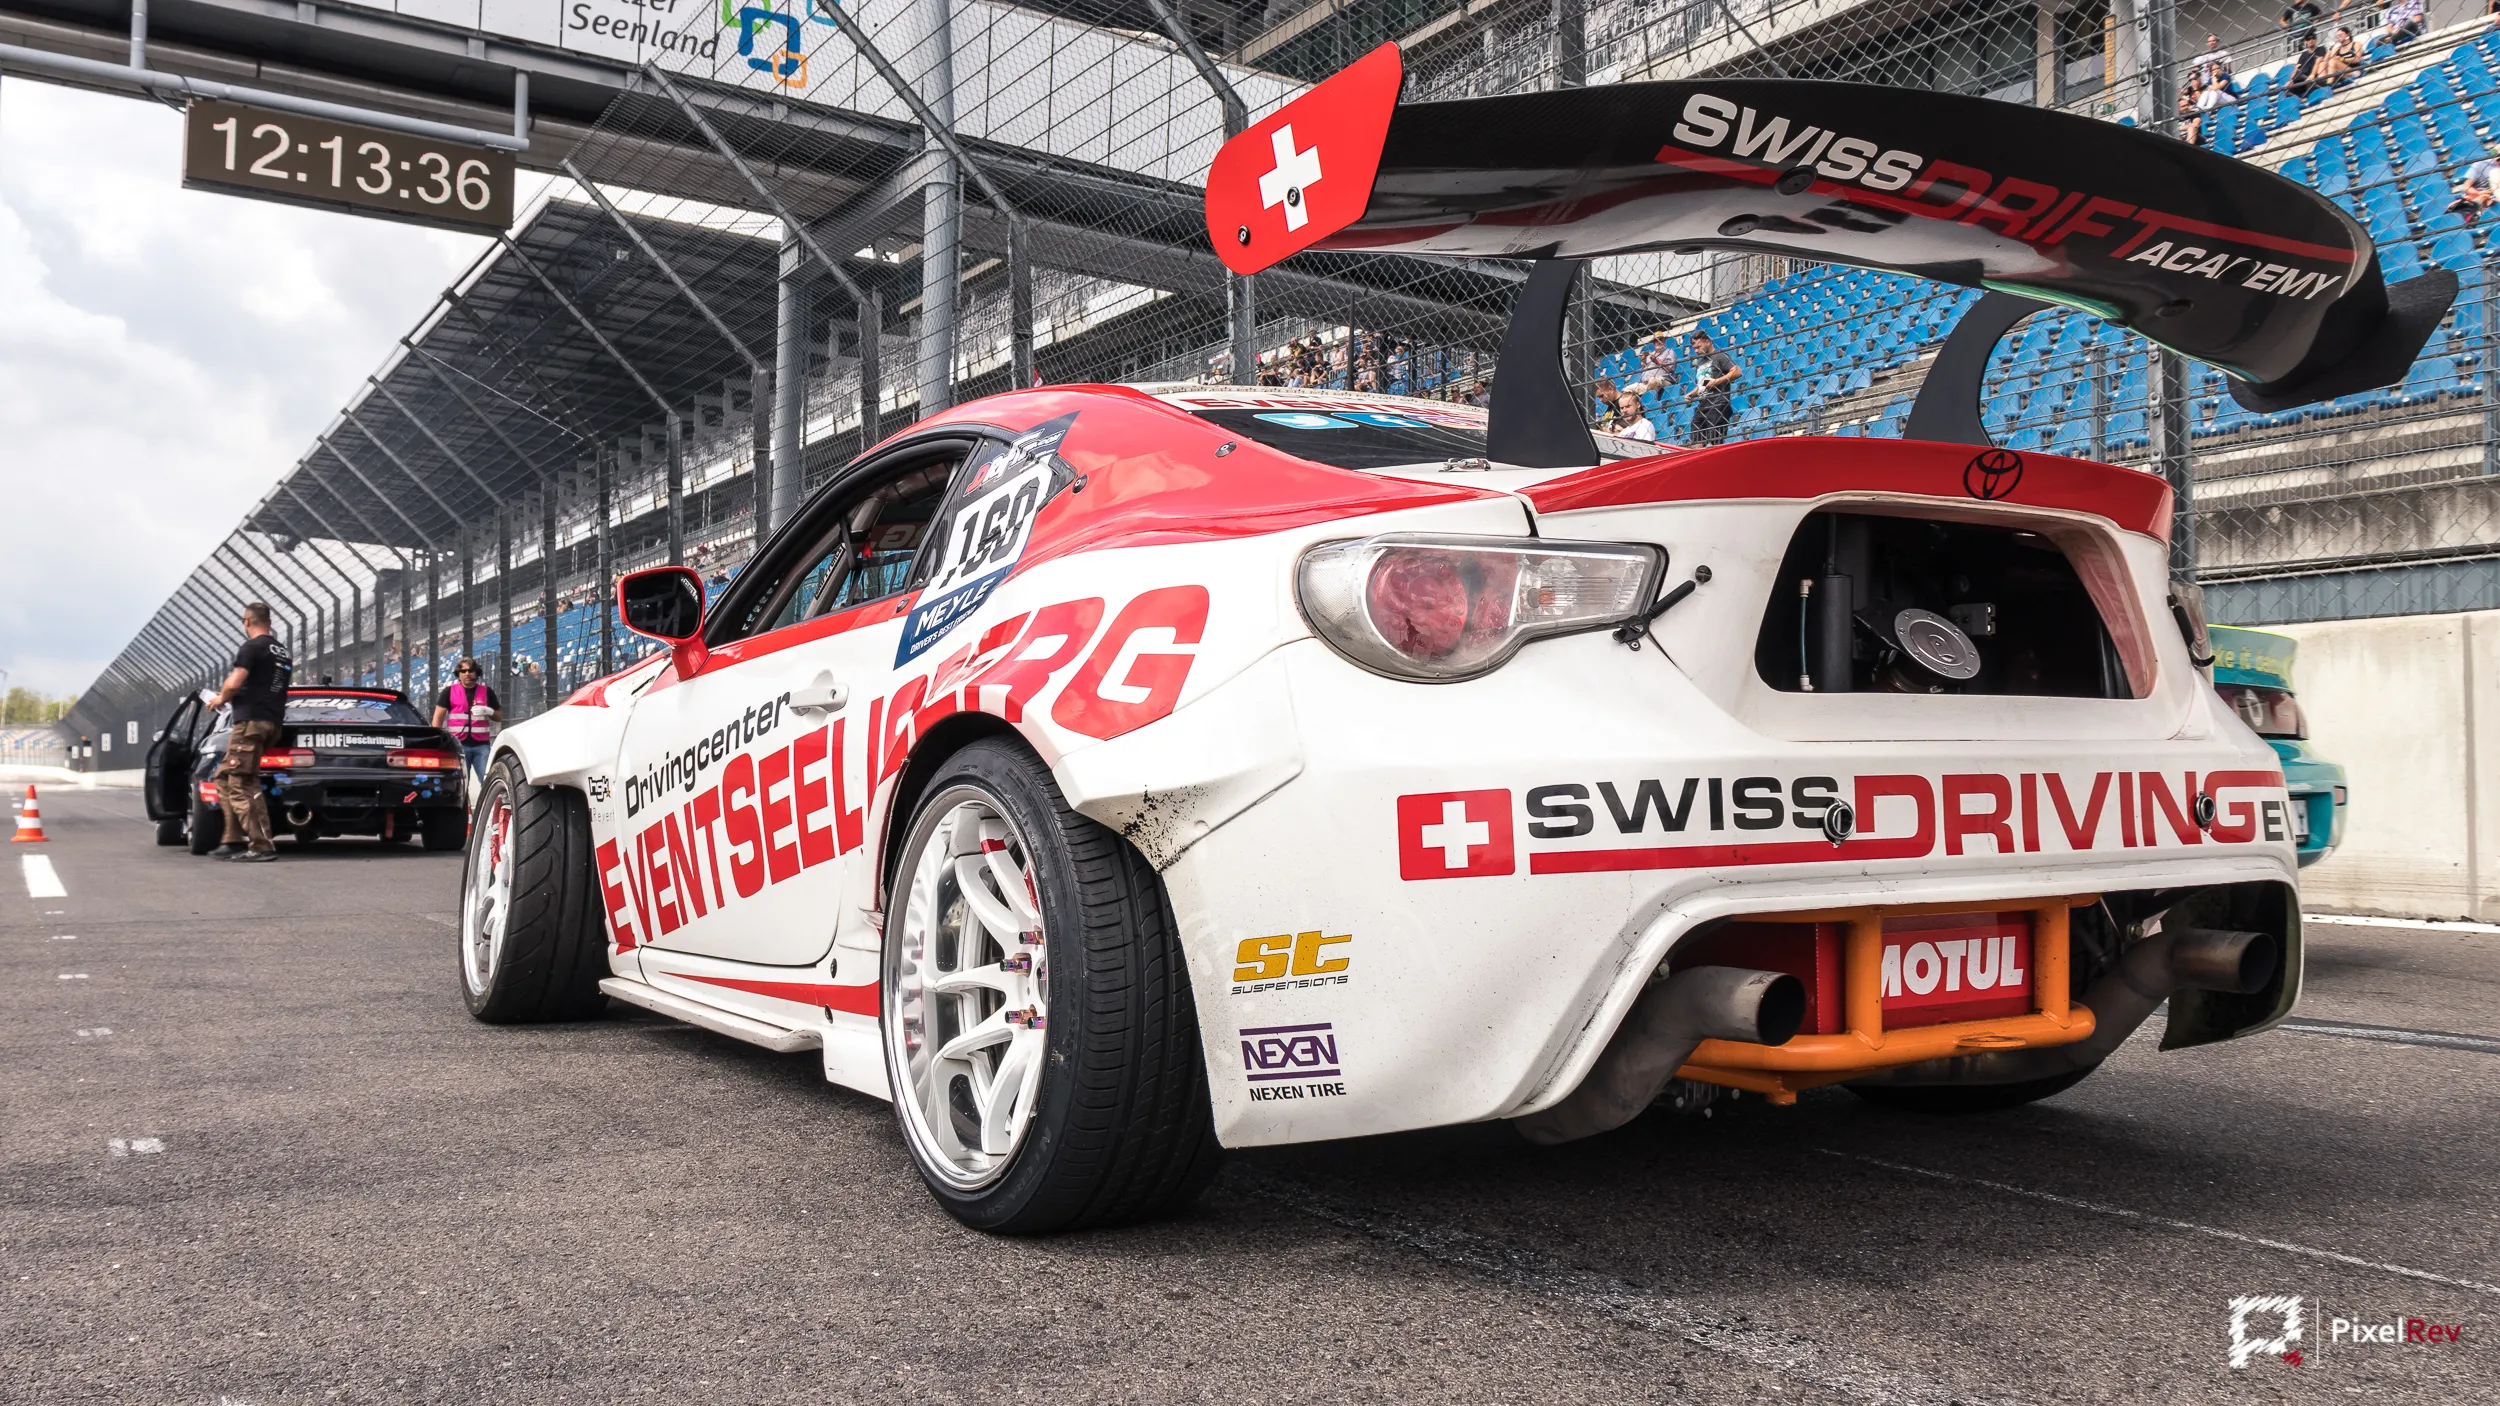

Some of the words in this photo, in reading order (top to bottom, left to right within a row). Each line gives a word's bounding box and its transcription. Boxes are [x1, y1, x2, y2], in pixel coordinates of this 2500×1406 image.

[568, 3, 720, 60] Seenland
[213, 117, 490, 211] 12:13:36
[1673, 93, 1923, 191] SWISS
[1902, 159, 2170, 259] DRIFT
[2126, 241, 2342, 300] ACAEMY
[939, 476, 1040, 589] 160
[914, 577, 997, 637] MEYLE
[909, 630, 939, 655] DRIVER'S
[937, 620, 955, 638] BEST
[315, 733, 343, 747] HOF
[345, 735, 401, 747] Beschriftung
[626, 692, 791, 819] Drivingcenter
[1526, 776, 1841, 839] SWISS
[1854, 770, 2284, 858] DRIVING
[1231, 975, 1349, 996] SUSPENSIONS
[1241, 1034, 1339, 1070] NEXEN
[1250, 1085, 1304, 1101] NEXEN
[1306, 1082, 1346, 1097] TIRE
